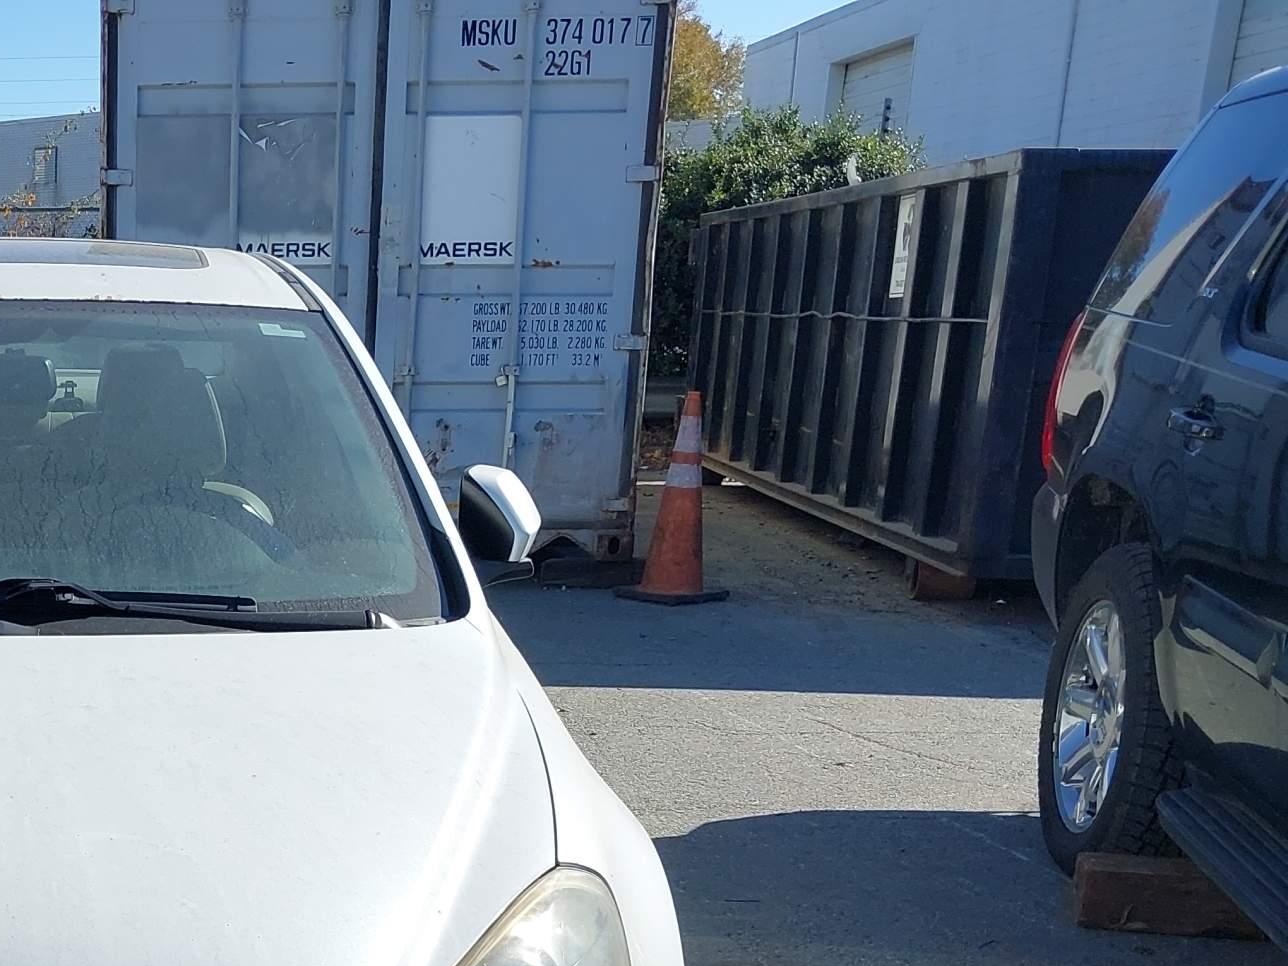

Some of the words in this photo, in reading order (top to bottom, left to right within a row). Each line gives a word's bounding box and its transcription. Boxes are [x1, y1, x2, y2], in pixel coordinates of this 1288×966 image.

[462, 19, 517, 46] MSKU
[544, 49, 592, 76] 22G1
[236, 242, 331, 257] MAERSK
[420, 241, 513, 257] MAERSK
[472, 319, 507, 333] PAYLOAD
[470, 353, 490, 367] CUBE
[571, 353, 591, 367] 33.2
